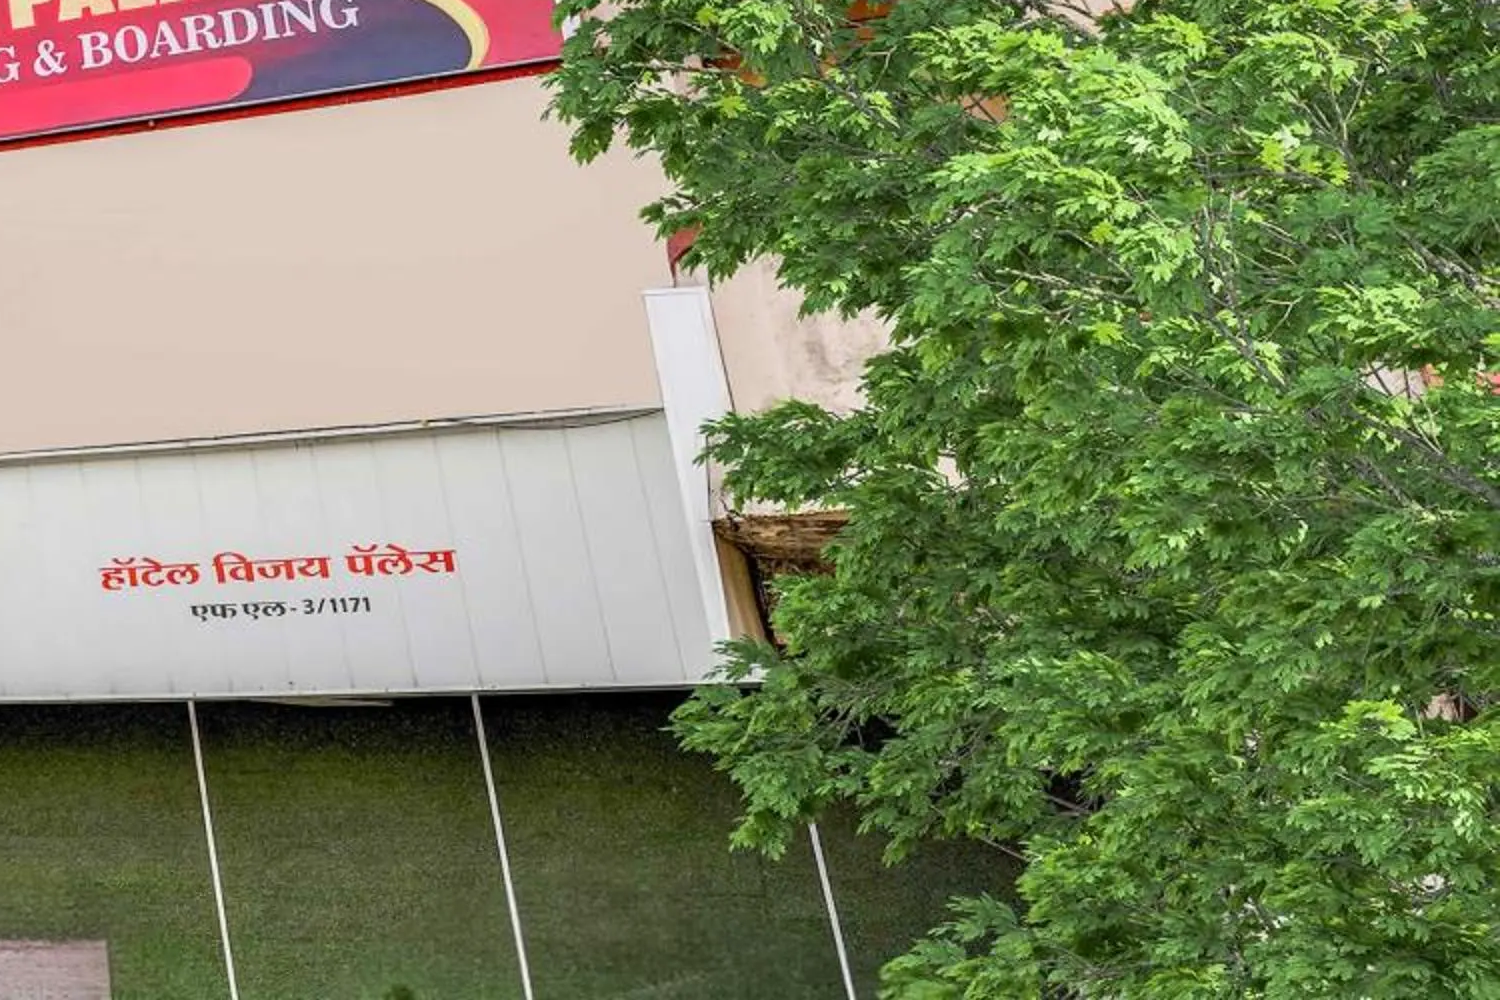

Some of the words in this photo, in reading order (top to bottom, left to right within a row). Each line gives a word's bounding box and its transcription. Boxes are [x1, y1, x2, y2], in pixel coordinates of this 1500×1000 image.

[33, 41, 67, 76] &
[98, 557, 200, 592] हॉटेल
[212, 551, 331, 585] विजय
[344, 543, 457, 577] पॅलेस
